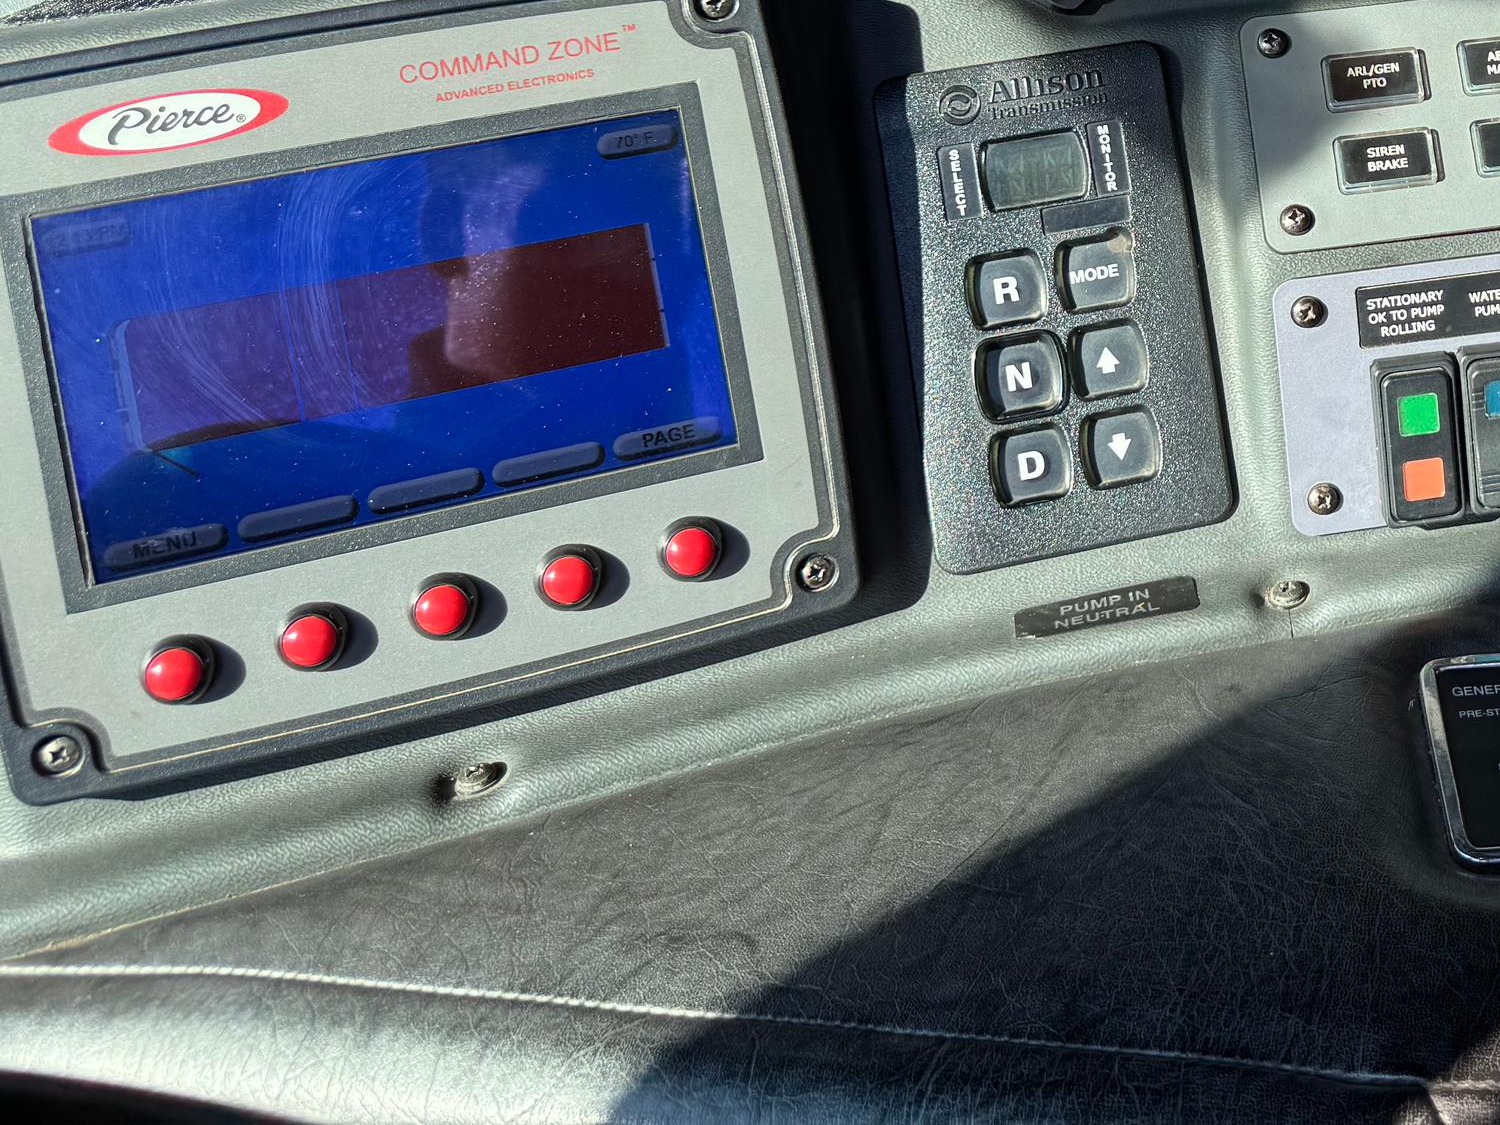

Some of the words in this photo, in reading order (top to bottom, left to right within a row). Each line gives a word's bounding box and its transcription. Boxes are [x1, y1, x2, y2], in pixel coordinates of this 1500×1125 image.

[400, 45, 539, 83] COMMAND
[549, 33, 620, 61] ZONE
[1347, 62, 1399, 76] ARL/GEN
[436, 83, 504, 102] ADVANCED
[508, 69, 594, 91] ELECTRONICS
[987, 70, 1105, 104] Allison
[1363, 77, 1387, 88] PTO
[988, 92, 1108, 120] Transmission
[107, 104, 234, 145] Pierce
[1097, 125, 1117, 191] MONITOR
[1367, 144, 1405, 158] SIREN
[1368, 158, 1408, 172] BRAKE
[949, 150, 967, 216] SELECT
[1071, 264, 1119, 284] MODE
[994, 277, 1019, 304] R
[1367, 290, 1443, 310] STATIONARY
[1369, 312, 1387, 324] OK
[1389, 309, 1407, 321] TO
[1411, 305, 1445, 319] PUMP
[1381, 320, 1435, 337] ROLLING
[1006, 363, 1032, 390] N
[642, 424, 696, 447] PAGE
[1018, 452, 1046, 480] D
[132, 531, 196, 558] MENU
[1060, 595, 1122, 615] PUMP
[1128, 589, 1149, 601] IN
[1055, 603, 1160, 628] NEUTRAL
